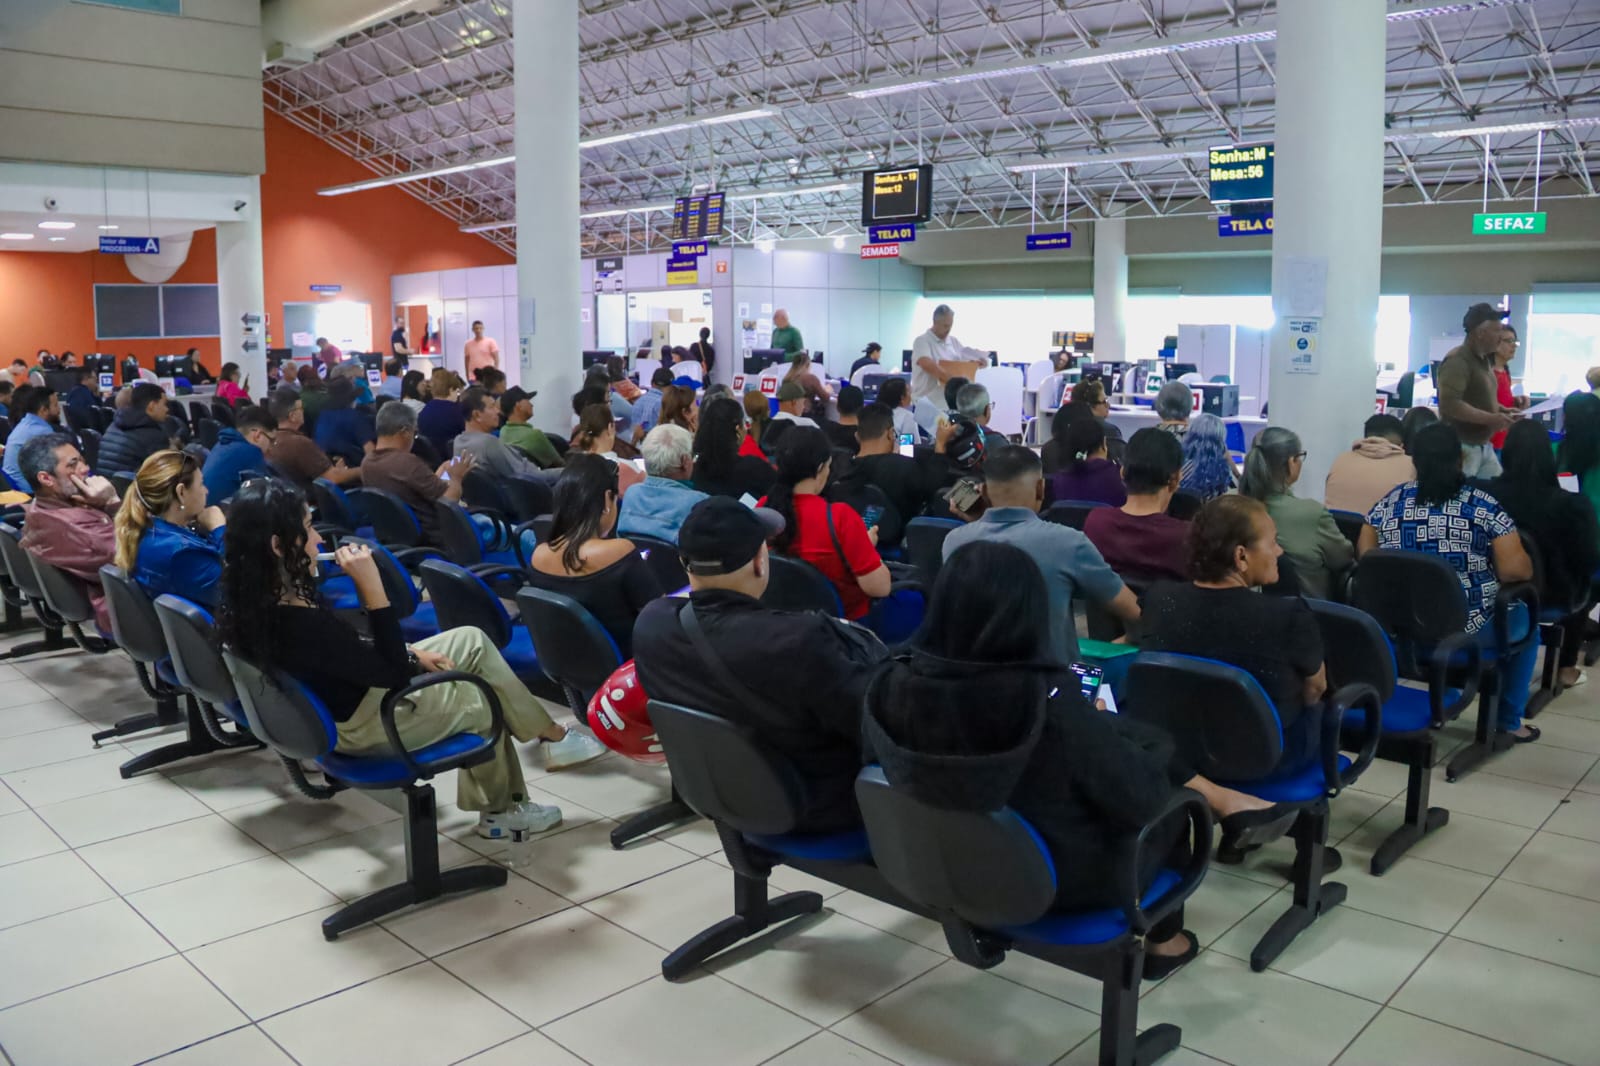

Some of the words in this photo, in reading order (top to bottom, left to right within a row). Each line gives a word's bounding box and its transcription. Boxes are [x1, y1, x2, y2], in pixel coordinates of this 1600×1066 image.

[1210, 147, 1266, 164] Senha:M
[1210, 165, 1264, 181] Mesa:56
[1230, 219, 1263, 231] TELA
[1265, 218, 1274, 229] 0
[1484, 217, 1534, 230] SEFAZ
[877, 230, 899, 239] TELA
[901, 229, 911, 237] 01
[145, 238, 158, 252] A
[678, 246, 696, 254] TELA
[861, 245, 898, 257] SEMADES
